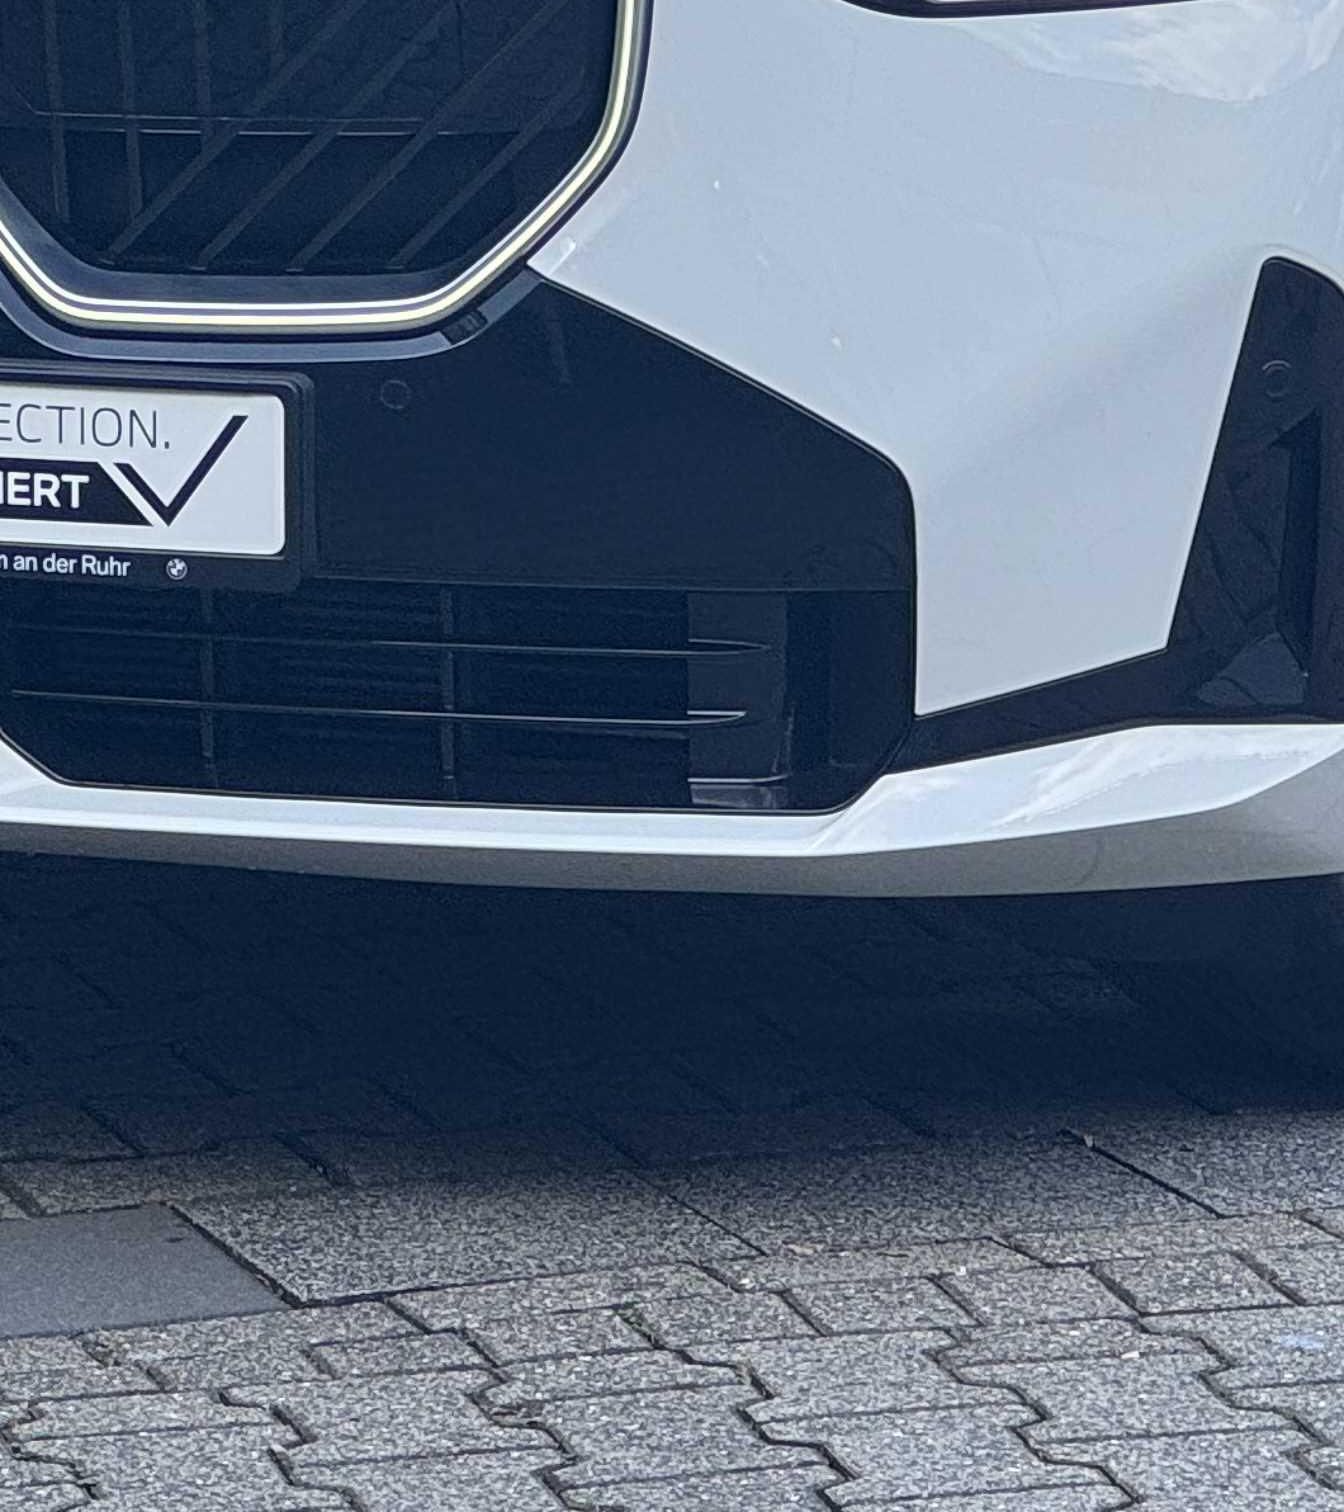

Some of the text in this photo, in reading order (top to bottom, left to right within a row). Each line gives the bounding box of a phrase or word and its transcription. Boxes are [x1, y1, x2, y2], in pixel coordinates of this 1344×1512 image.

[12, 555, 38, 573] an
[42, 552, 76, 574] der
[81, 554, 132, 577] Ruhr
